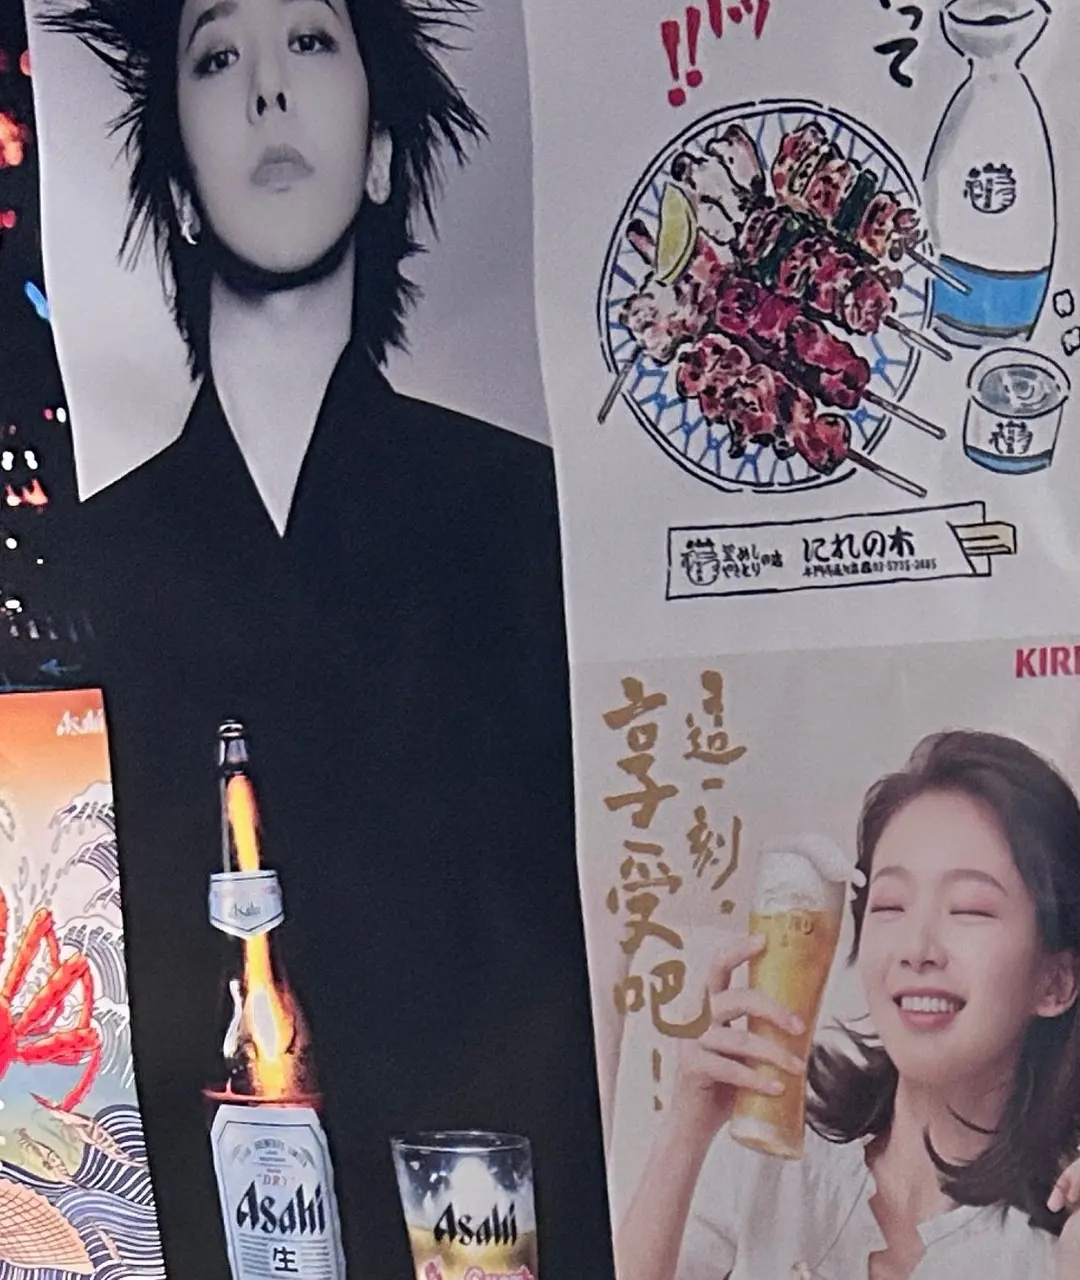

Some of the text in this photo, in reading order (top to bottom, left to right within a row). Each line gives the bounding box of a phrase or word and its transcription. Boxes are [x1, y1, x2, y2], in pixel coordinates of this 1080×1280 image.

[236, 1180, 325, 1235] Asahi
[433, 1201, 518, 1246] Asahi
[273, 1246, 299, 1273] 生
